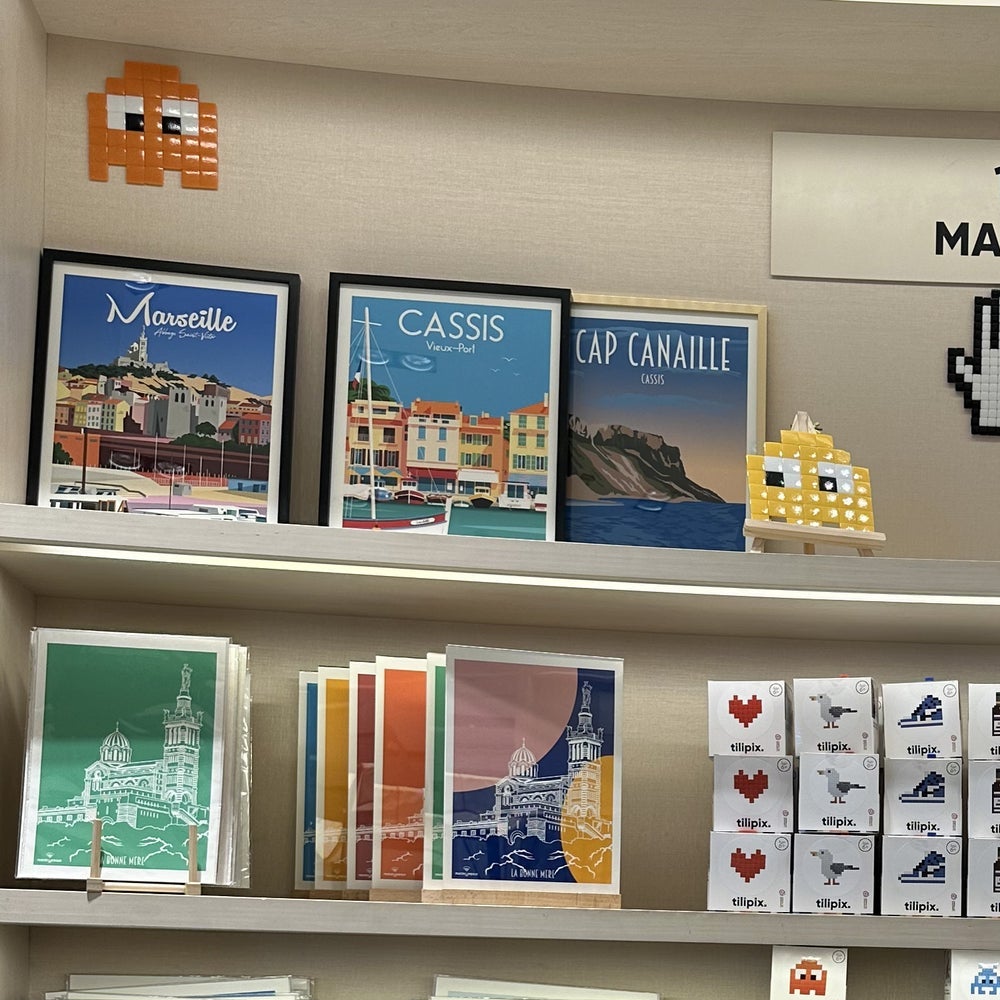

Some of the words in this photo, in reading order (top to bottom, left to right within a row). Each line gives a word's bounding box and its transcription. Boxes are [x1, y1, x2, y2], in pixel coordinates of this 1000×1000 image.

[106, 291, 237, 332] Marseille
[398, 309, 505, 342] CASSIS
[575, 329, 618, 365] CAP
[628, 332, 731, 371] CANAILLE
[641, 373, 665, 385] CASSIS
[731, 743, 764, 754] tilipix.
[817, 742, 851, 753] tilipix.
[907, 745, 940, 757] tilipix.
[737, 818, 771, 829] tilipix.
[822, 816, 856, 828] tilipix.
[907, 821, 940, 833] tilipix.
[732, 897, 767, 909] tilipix.
[816, 899, 850, 910] tilipix.
[905, 901, 938, 913] tilipix.
